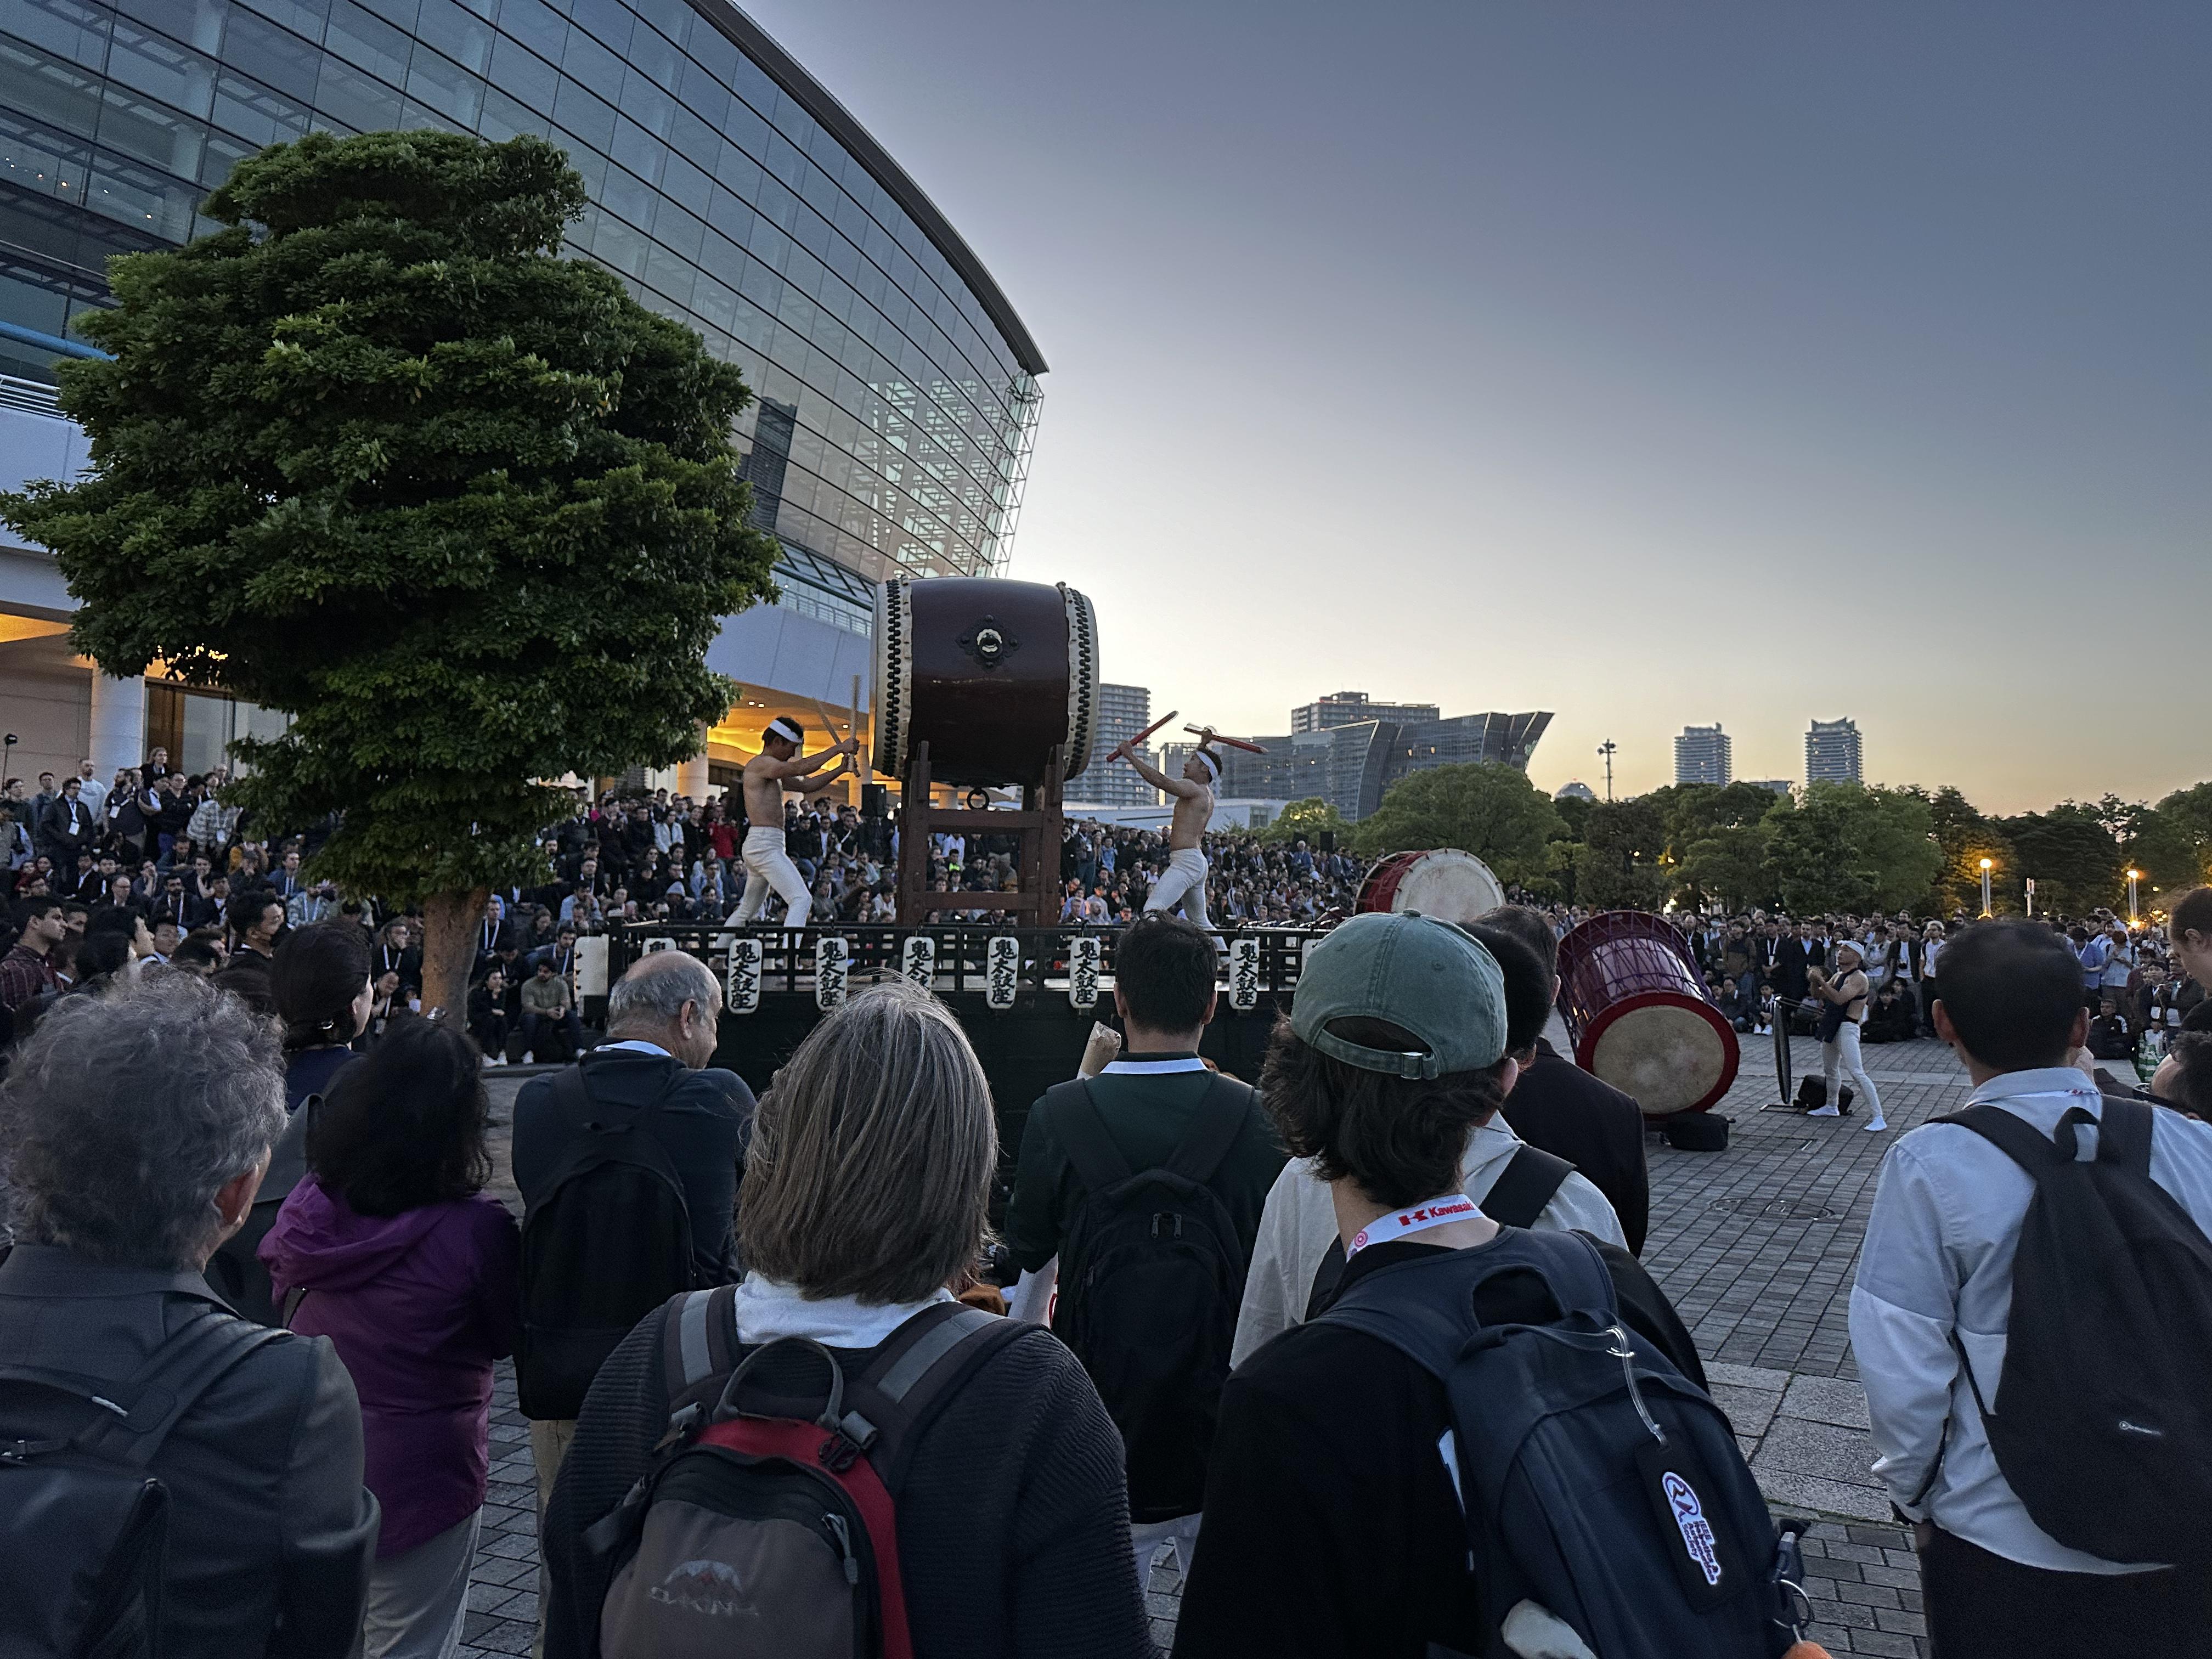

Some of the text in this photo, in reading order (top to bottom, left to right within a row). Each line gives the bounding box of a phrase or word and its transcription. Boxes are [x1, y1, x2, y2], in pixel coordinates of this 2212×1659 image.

[730, 942, 760, 1009] 鬼太鼓座
[990, 939, 1017, 1006] 鬼太鼓座
[1074, 940, 1099, 1005] 鬼太鼓座
[1234, 943, 1260, 1006] 鬼太鼓座
[1428, 1200, 1475, 1217] Kawasaki
[1681, 1523, 1699, 1557] Society
[1699, 1520, 1712, 1540] IEEE
